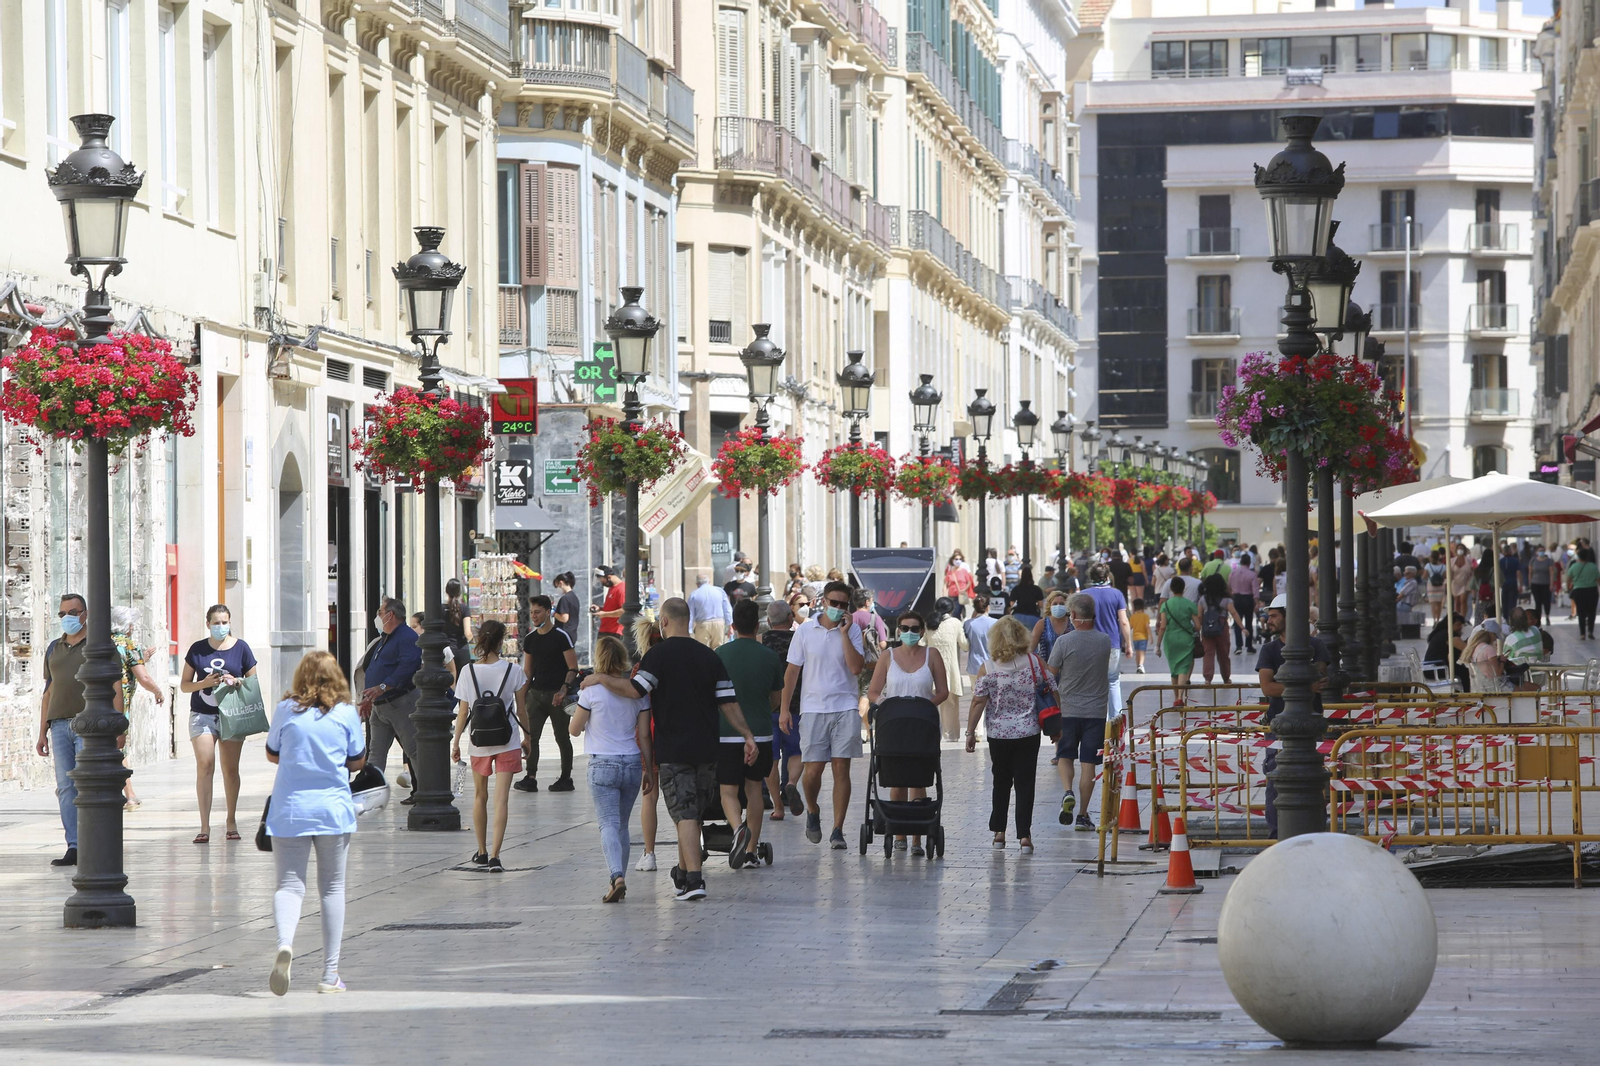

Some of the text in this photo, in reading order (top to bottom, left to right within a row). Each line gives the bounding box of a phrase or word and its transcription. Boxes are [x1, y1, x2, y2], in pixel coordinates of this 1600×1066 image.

[578, 365, 603, 380] OR
[498, 464, 525, 486] K
[498, 488, 526, 499] Kiehl's
